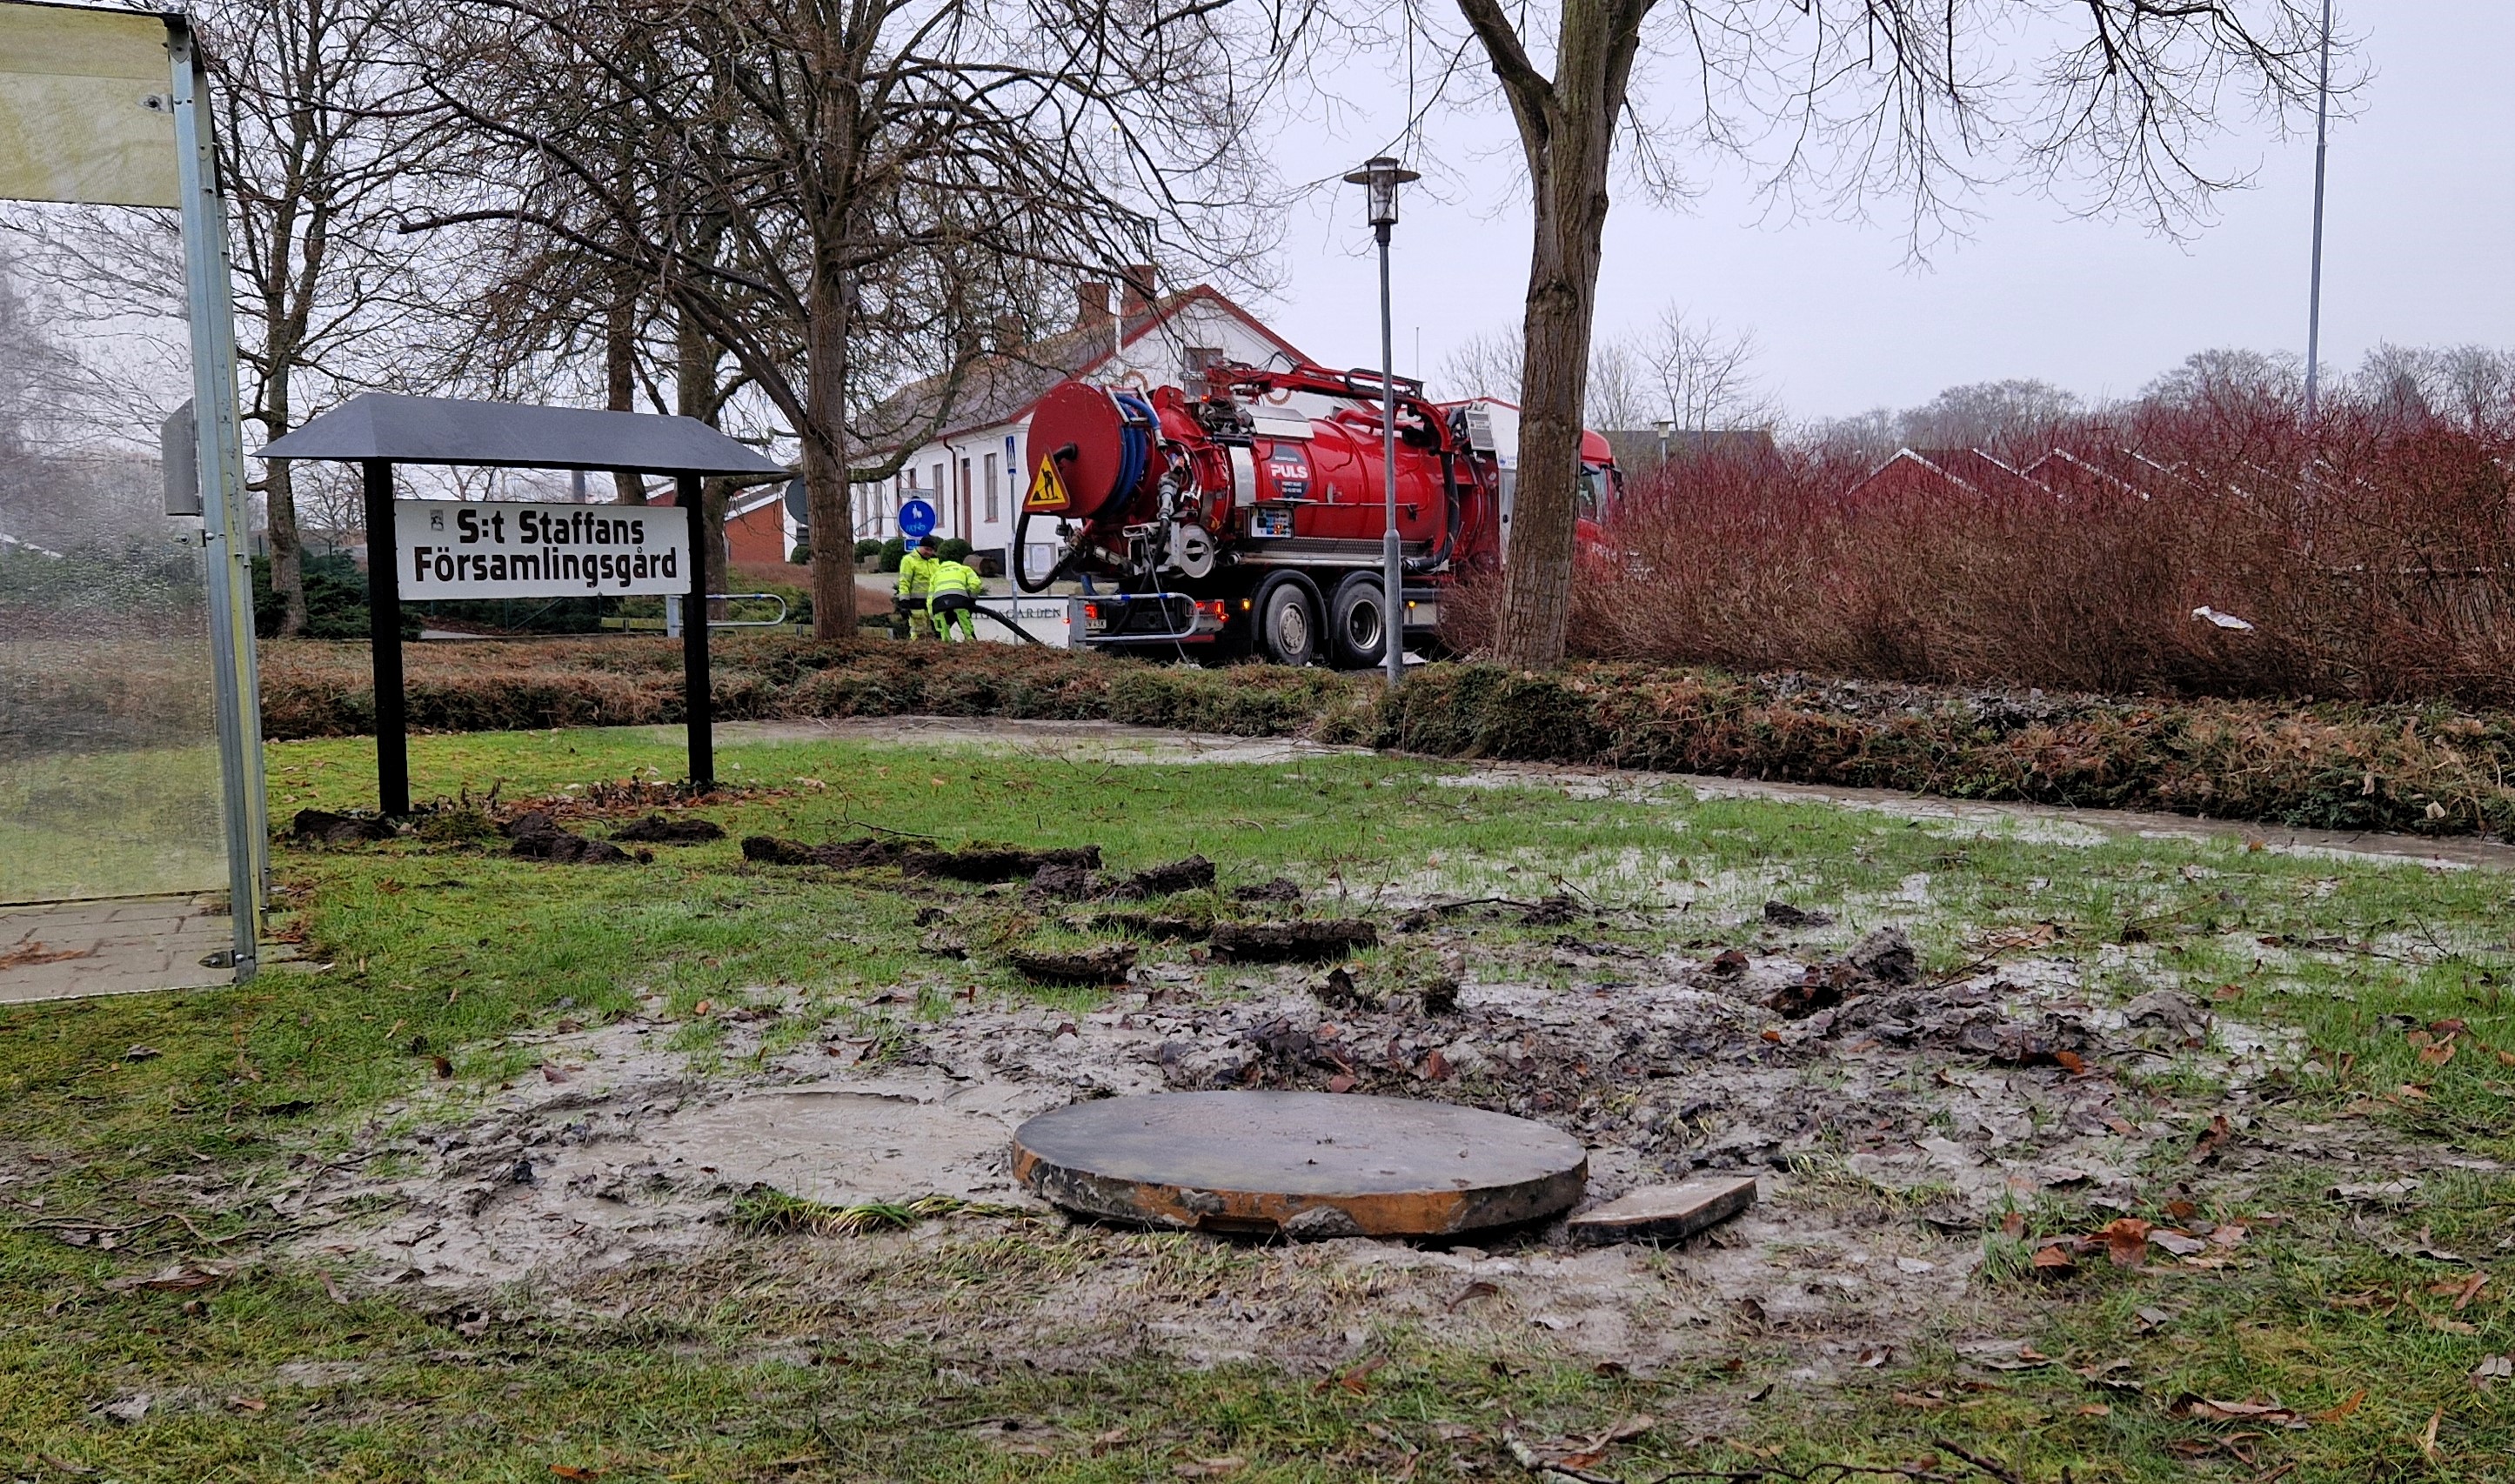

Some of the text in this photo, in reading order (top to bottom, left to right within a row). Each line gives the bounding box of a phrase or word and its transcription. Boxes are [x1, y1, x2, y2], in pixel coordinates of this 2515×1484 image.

[1270, 464, 1308, 478] PULS
[457, 509, 645, 545] S:t Staffans
[414, 546, 677, 588] Församlingsgård
